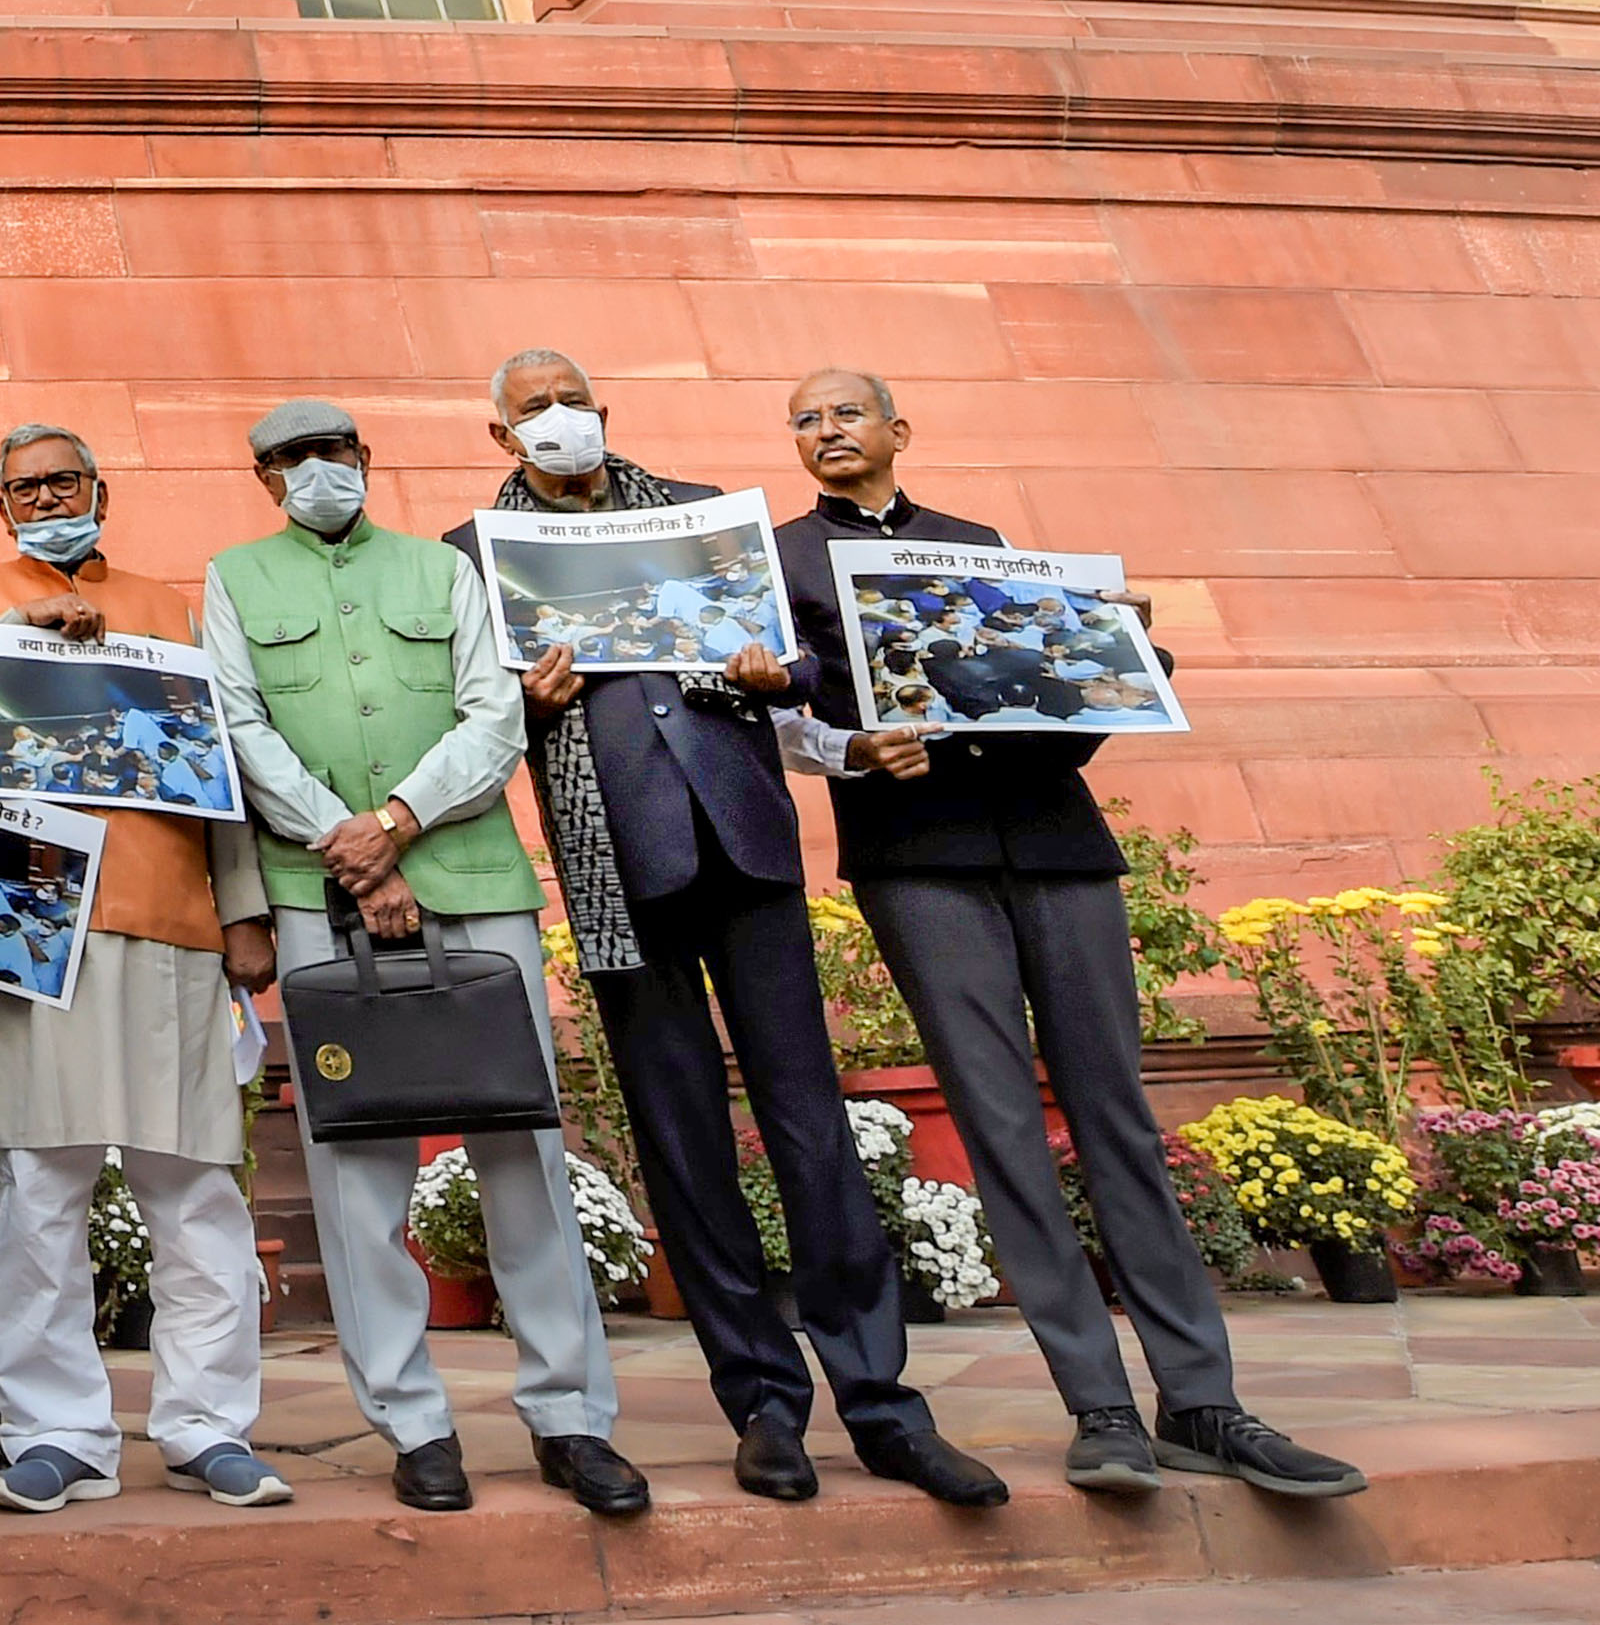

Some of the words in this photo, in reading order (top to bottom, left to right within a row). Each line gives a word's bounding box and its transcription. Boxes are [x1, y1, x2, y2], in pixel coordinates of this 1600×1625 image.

[538, 524, 567, 537] क्या
[569, 525, 592, 538] यह
[595, 516, 681, 536] लोकतांत्रिक
[683, 513, 694, 530] है
[17, 638, 43, 652] क्या
[46, 640, 66, 656] यह
[145, 646, 155, 664] है
[21, 808, 32, 829] है
